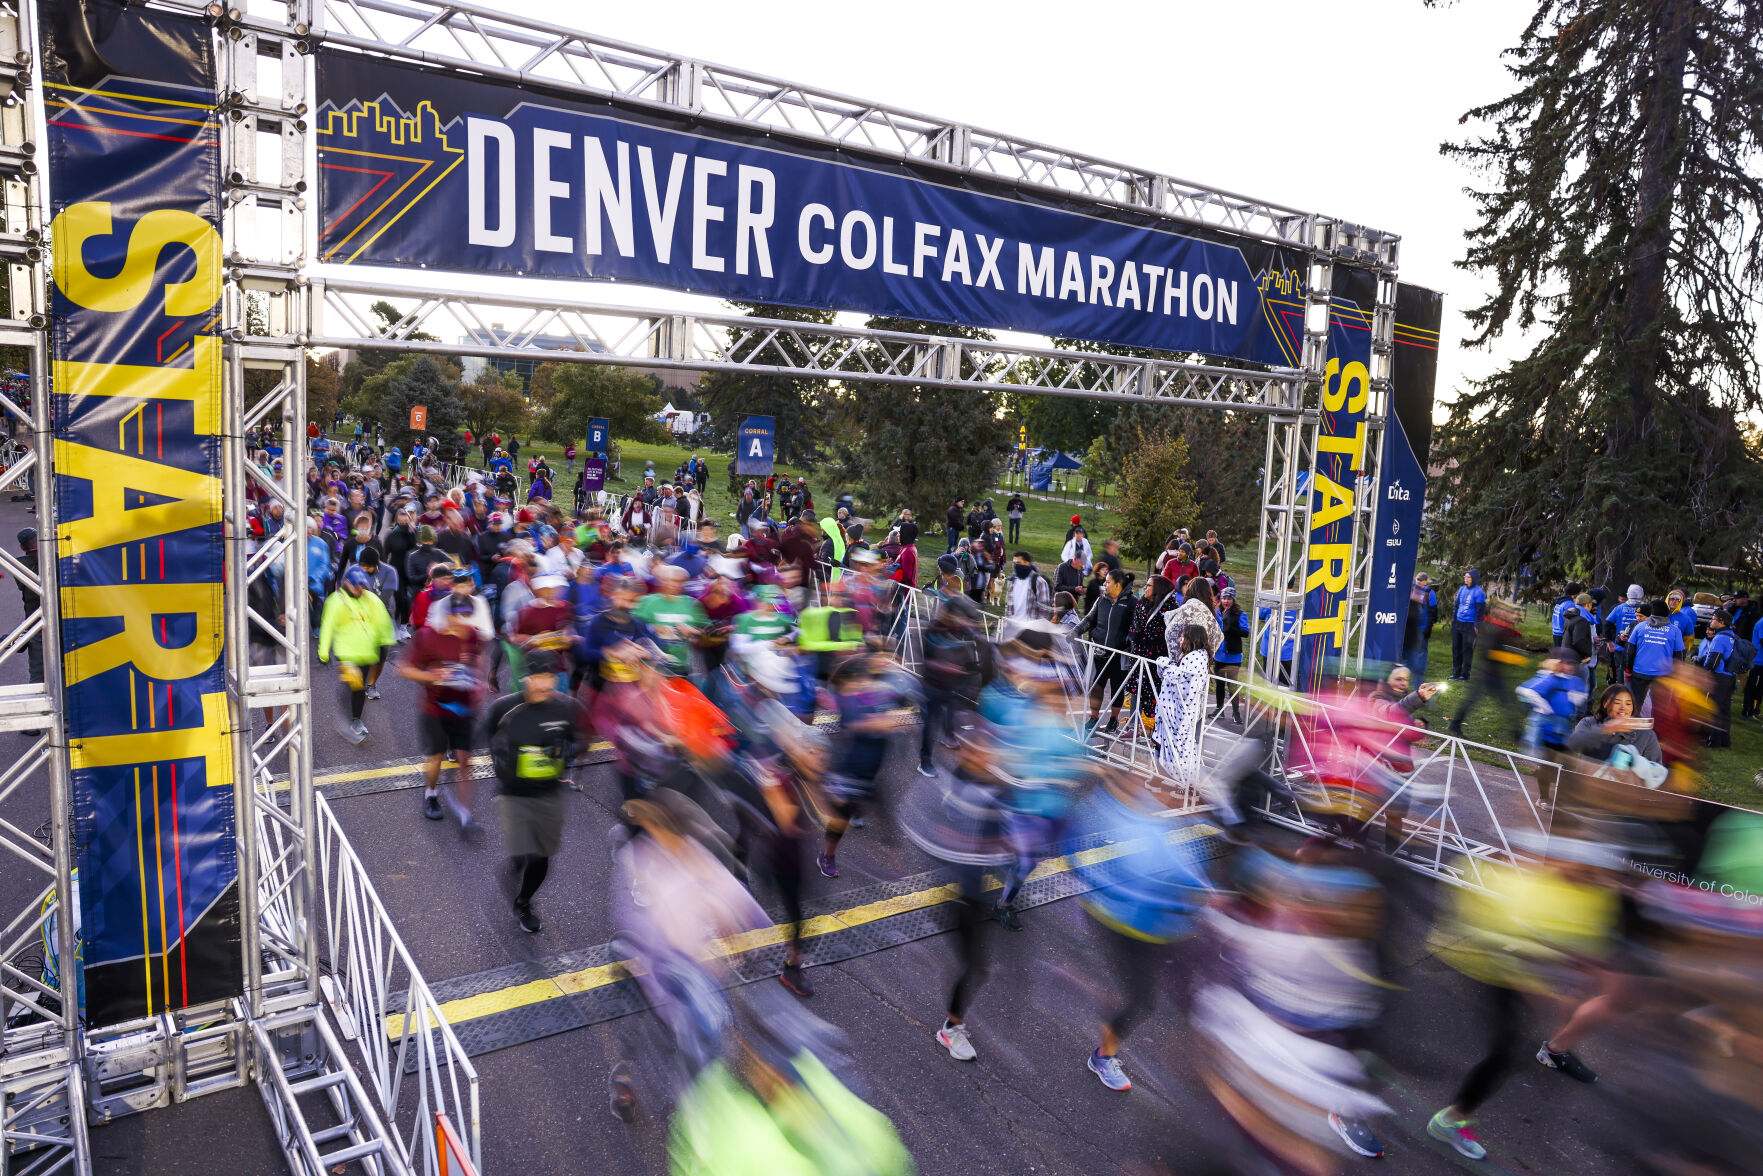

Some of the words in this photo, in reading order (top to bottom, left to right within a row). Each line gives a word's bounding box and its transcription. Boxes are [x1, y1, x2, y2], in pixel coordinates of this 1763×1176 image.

[467, 117, 776, 278] DENVER
[798, 203, 1005, 291] COLFAX
[1017, 242, 1238, 325] MARATHON
[415, 414, 422, 422] C
[593, 430, 602, 442] B
[1018, 425, 1026, 450] ATM
[749, 438, 763, 457] A
[52, 201, 234, 787] START
[1302, 357, 1370, 648] START
[1699, 880, 1717, 894] of
